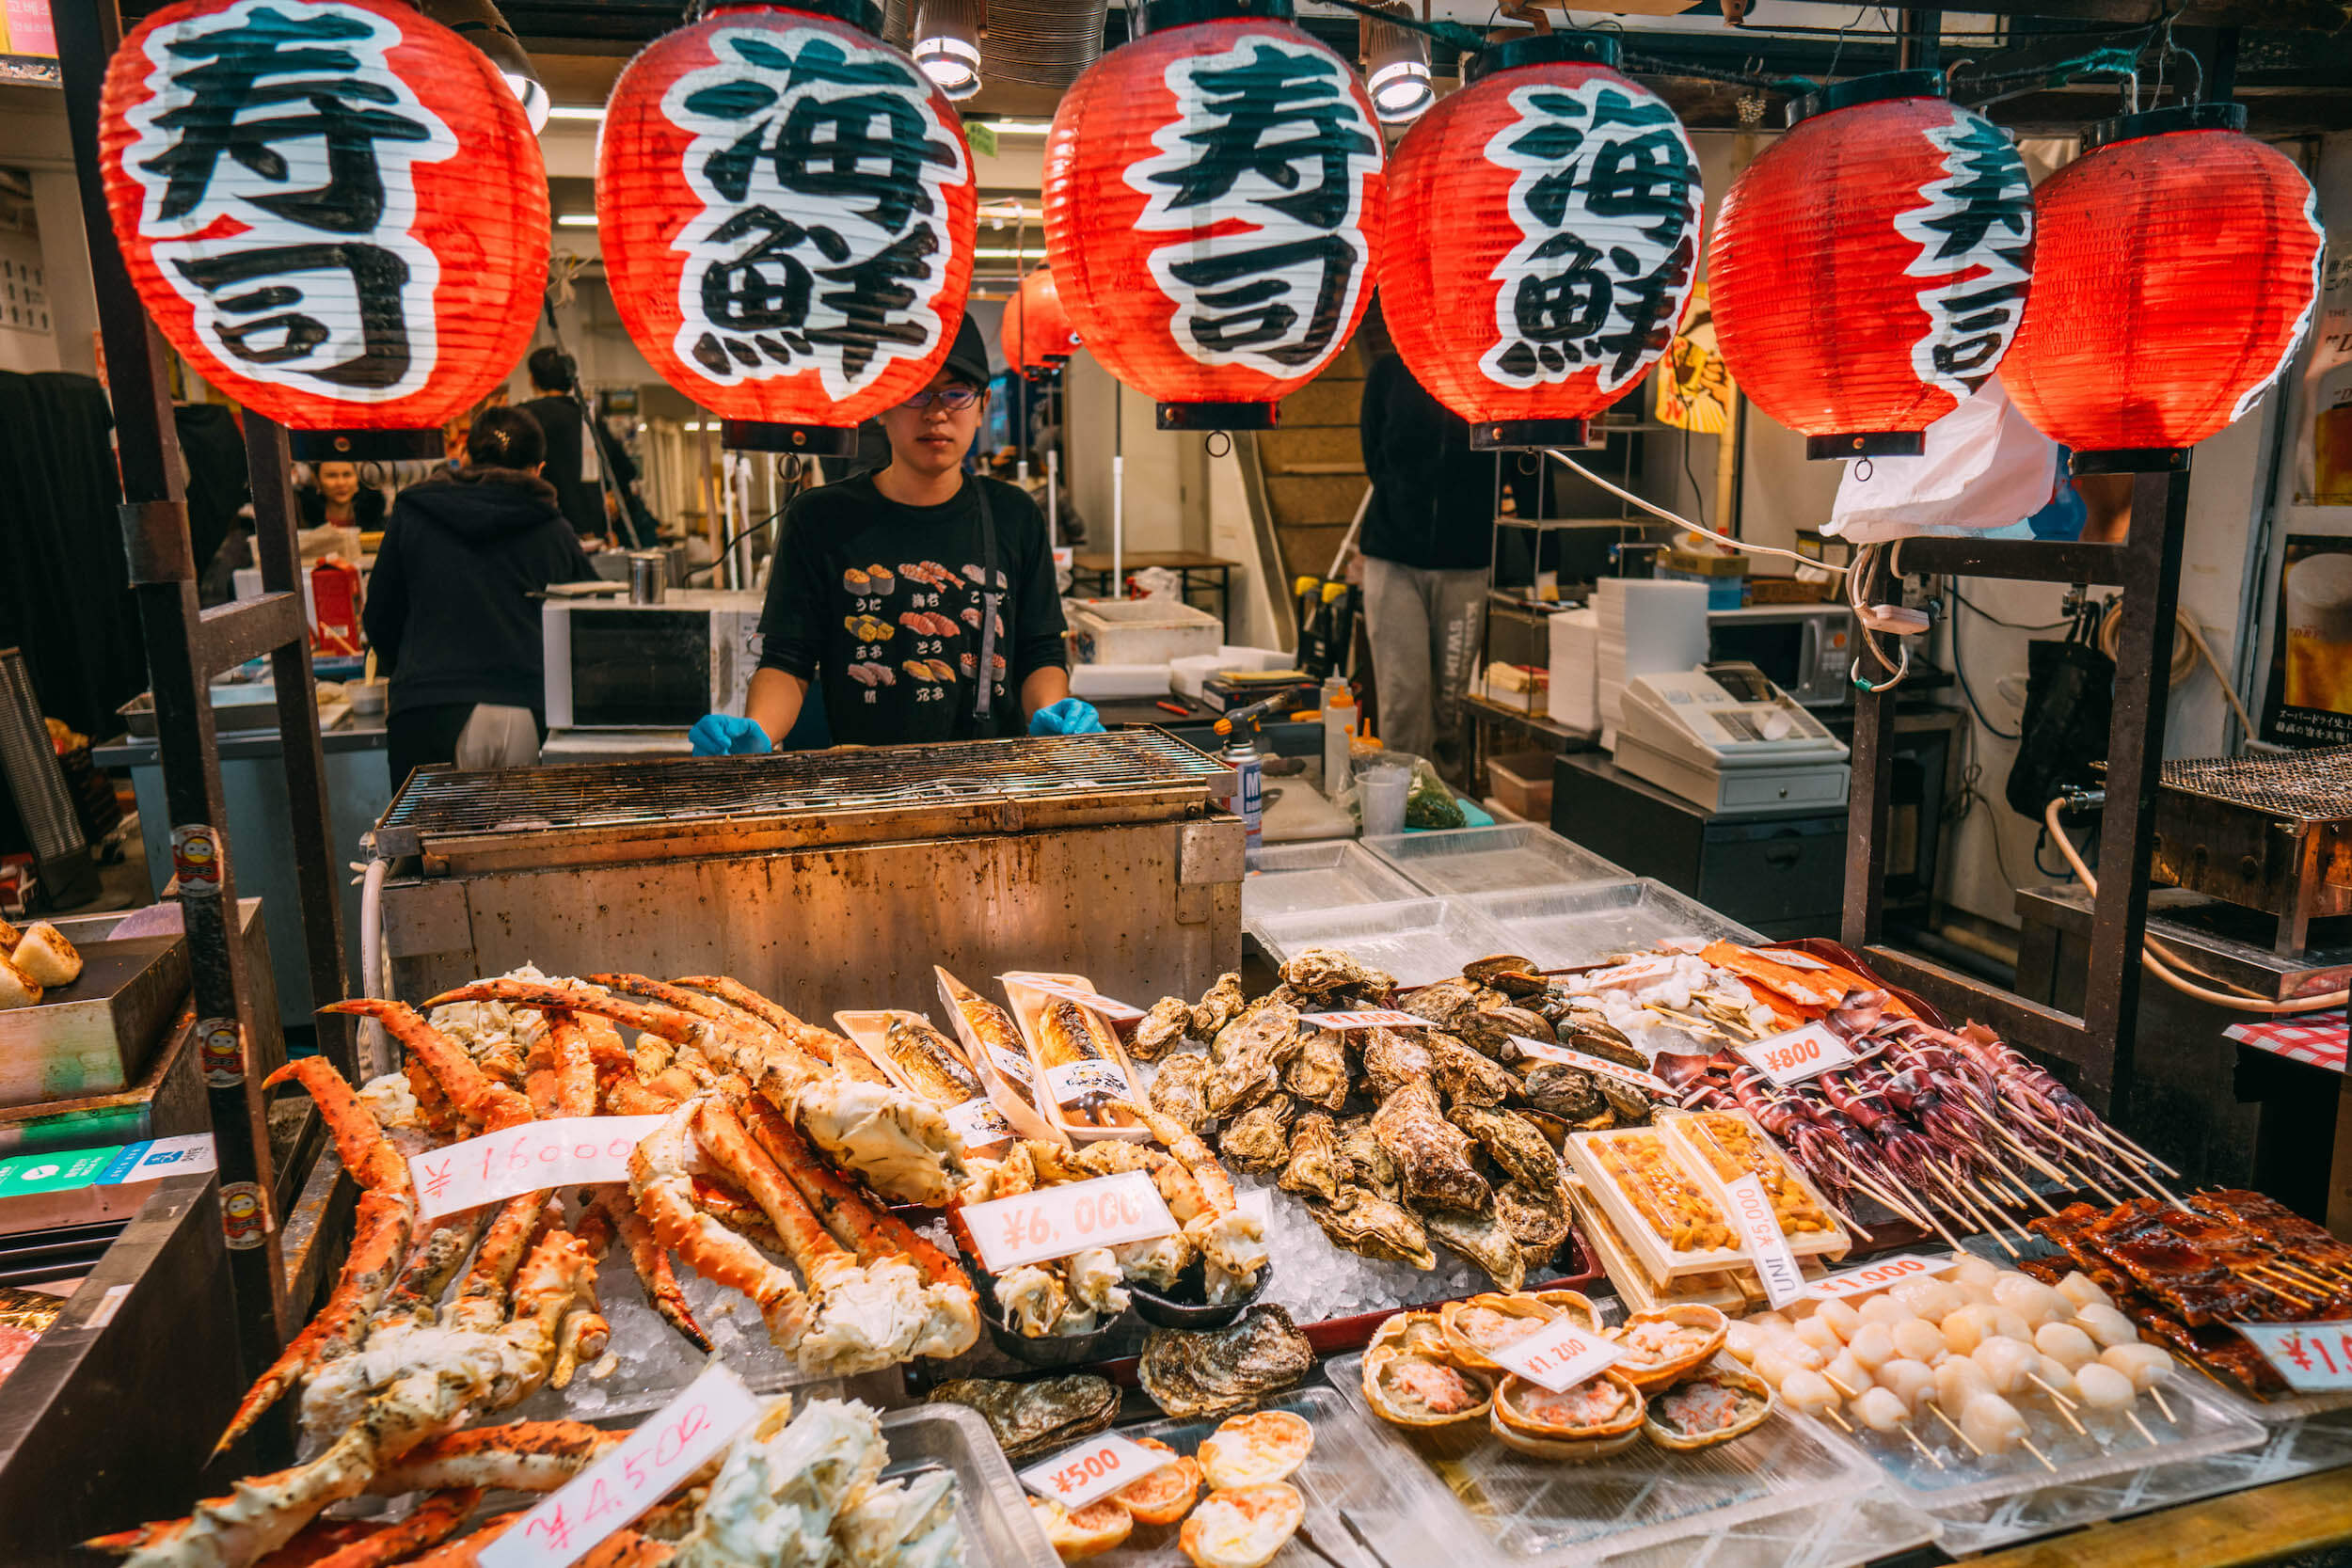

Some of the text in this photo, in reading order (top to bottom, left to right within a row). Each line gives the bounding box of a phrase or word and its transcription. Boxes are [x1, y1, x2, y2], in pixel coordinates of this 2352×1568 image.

[139, 7, 432, 388] 寿司
[683, 36, 957, 382] 海鮮
[1148, 44, 1376, 366] 寿司
[1497, 78, 1702, 383] 海鮮
[856, 598, 882, 611] うに
[916, 640, 943, 655] とろ
[1763, 1038, 1820, 1072] ¥800
[1765, 1256, 1796, 1292] UNI
[1049, 1448, 1121, 1494] ¥500
